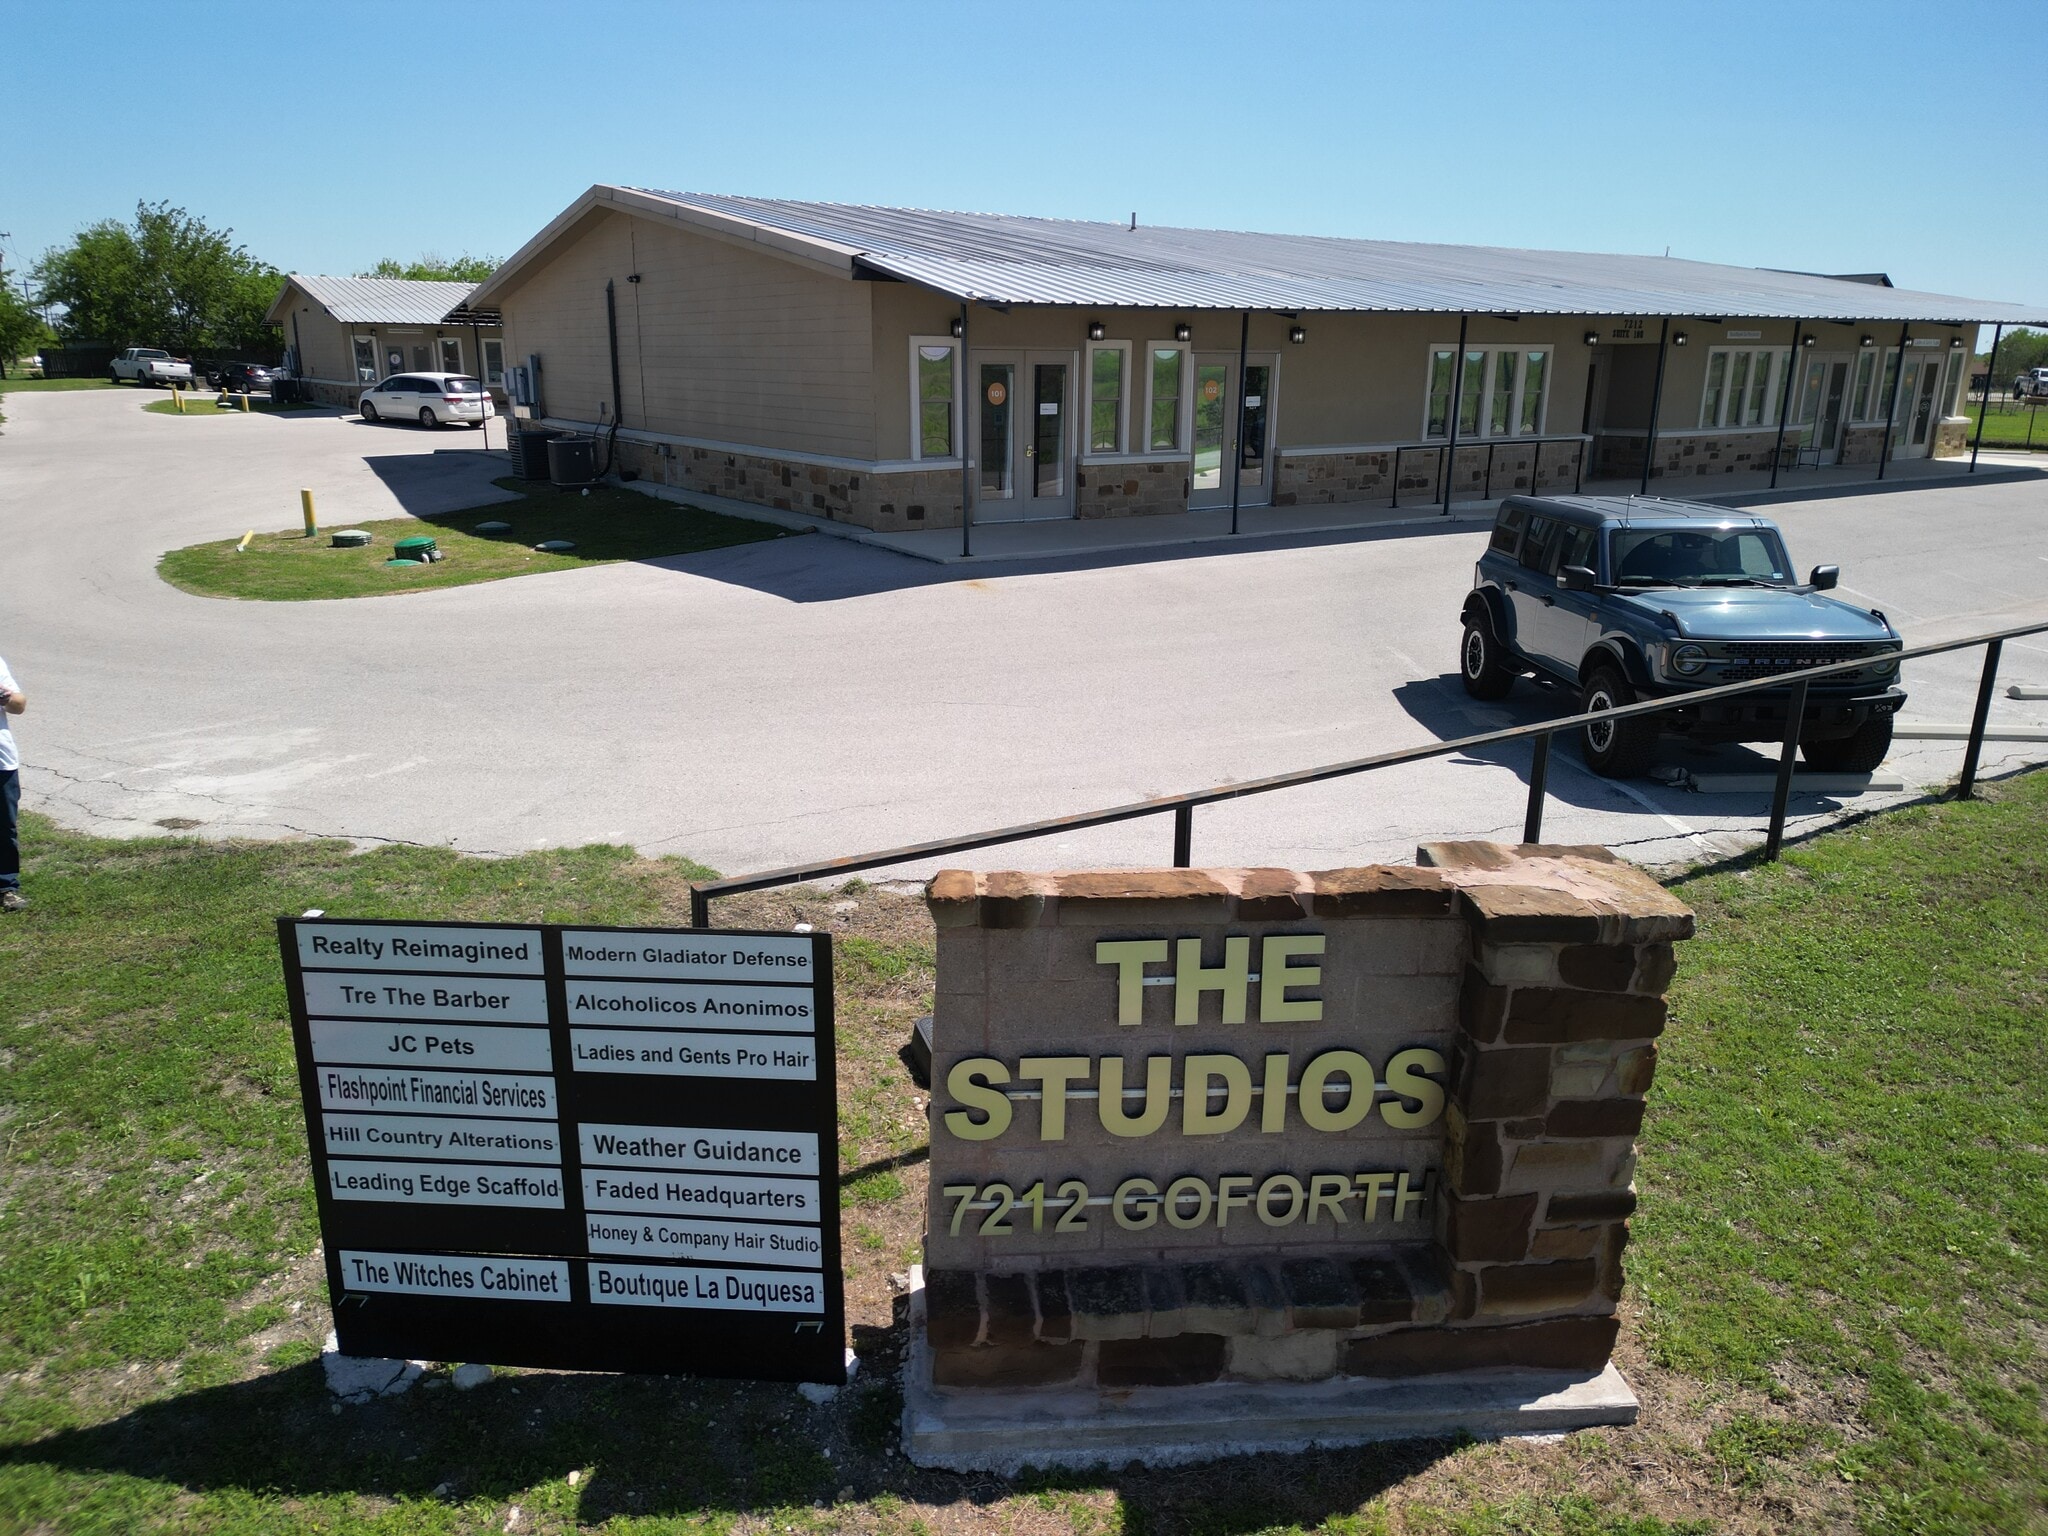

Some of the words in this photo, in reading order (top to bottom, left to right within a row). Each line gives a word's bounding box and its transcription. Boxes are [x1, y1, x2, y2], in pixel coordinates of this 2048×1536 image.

[1624, 319, 1643, 328] 7212
[1205, 386, 1217, 394] 102
[313, 936, 383, 960] Realty
[392, 939, 528, 963] Reimagined
[569, 946, 636, 961] Modern
[643, 949, 727, 964] Gladiator
[733, 951, 807, 966] Defense
[1095, 934, 1326, 1027] THE
[340, 986, 376, 1004] Tre
[383, 988, 425, 1005] The
[433, 989, 510, 1008] Barber
[576, 995, 696, 1013] Alcoholicos
[703, 999, 808, 1017] Anonimos
[388, 1036, 417, 1052] JC
[425, 1037, 474, 1054] Pets
[578, 1044, 635, 1061] Ladies
[641, 1047, 673, 1062] and
[679, 1047, 730, 1064] Gents
[737, 1050, 767, 1066] Pro
[774, 1051, 809, 1067] Hair
[328, 1074, 407, 1106] Flashpoint
[410, 1078, 477, 1104] Financial
[482, 1081, 546, 1108] Services
[943, 1048, 1447, 1142] STUDIOS
[330, 1127, 360, 1141] Hill
[367, 1128, 442, 1148] Country
[449, 1132, 553, 1150] Alterations
[593, 1135, 686, 1157] Weather
[694, 1139, 801, 1163] Guidance
[335, 1172, 413, 1196] Leading
[420, 1175, 470, 1197] Edge
[477, 1177, 558, 1196] Scaffold
[596, 1180, 658, 1200] Faded
[666, 1183, 805, 1208] Headquarters
[943, 1182, 1088, 1237] 7212
[1112, 1170, 1436, 1231] GOFORTH
[590, 1223, 637, 1245] Honey
[643, 1227, 653, 1242] &
[659, 1228, 729, 1250] Company
[735, 1232, 765, 1248] Hair
[770, 1234, 819, 1252] Studio
[352, 1259, 389, 1283] The
[394, 1262, 474, 1288] Witches
[481, 1266, 558, 1293] Cabinet
[599, 1271, 688, 1302] Boutique
[696, 1275, 719, 1299] La
[726, 1276, 814, 1307] Duquesa
